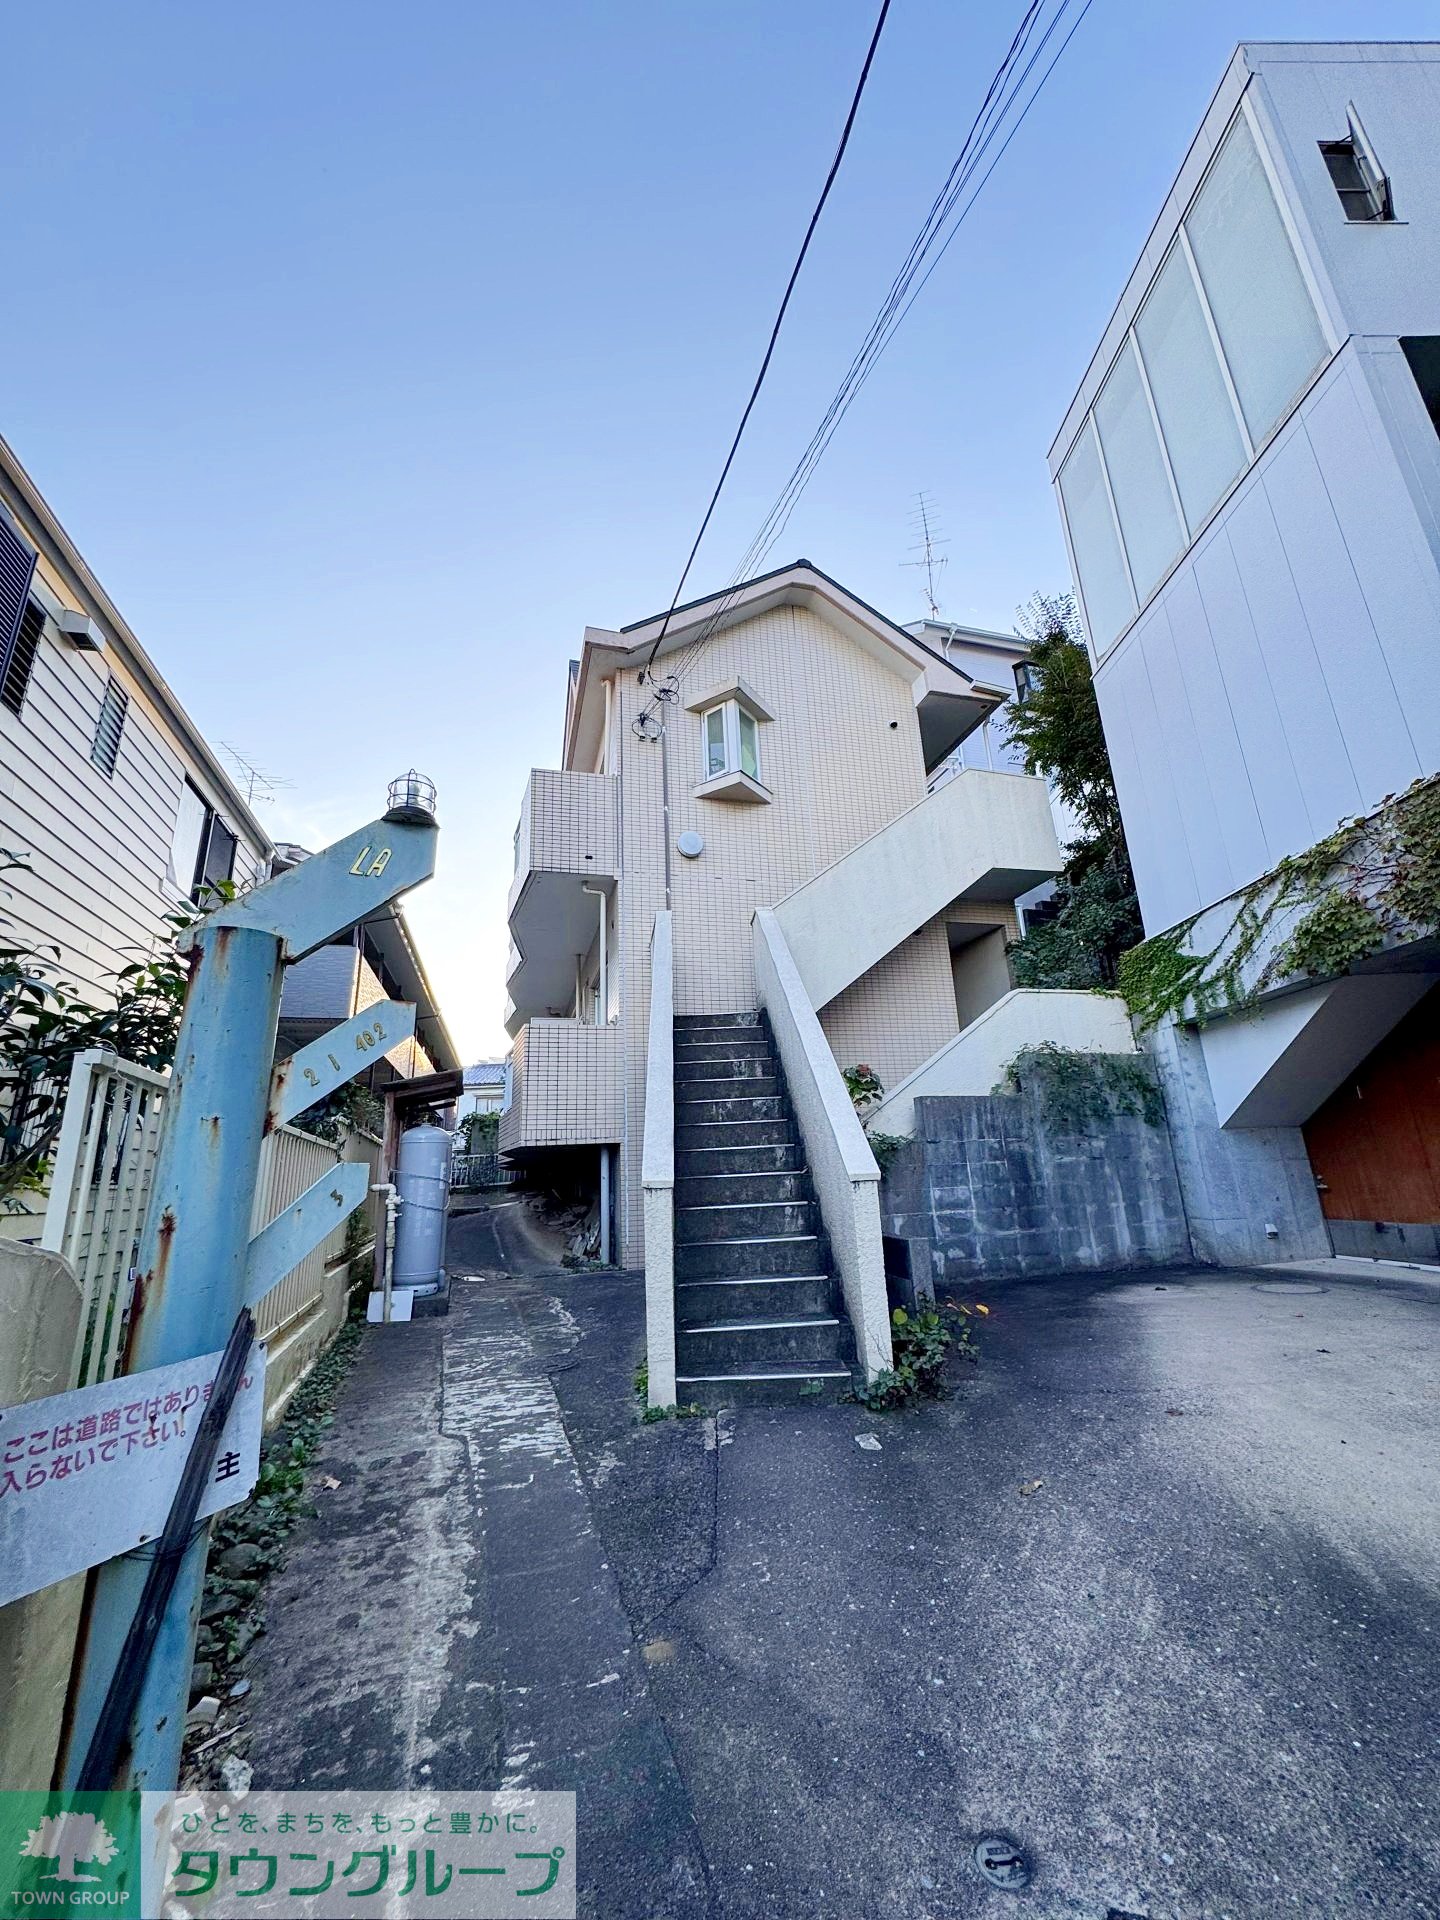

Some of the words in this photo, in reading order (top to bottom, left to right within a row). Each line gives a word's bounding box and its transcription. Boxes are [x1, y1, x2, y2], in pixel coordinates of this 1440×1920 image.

[349, 845, 393, 878] LA
[303, 1067, 321, 1087] 2
[4, 1371, 254, 1463] ここは道路ではありまん
